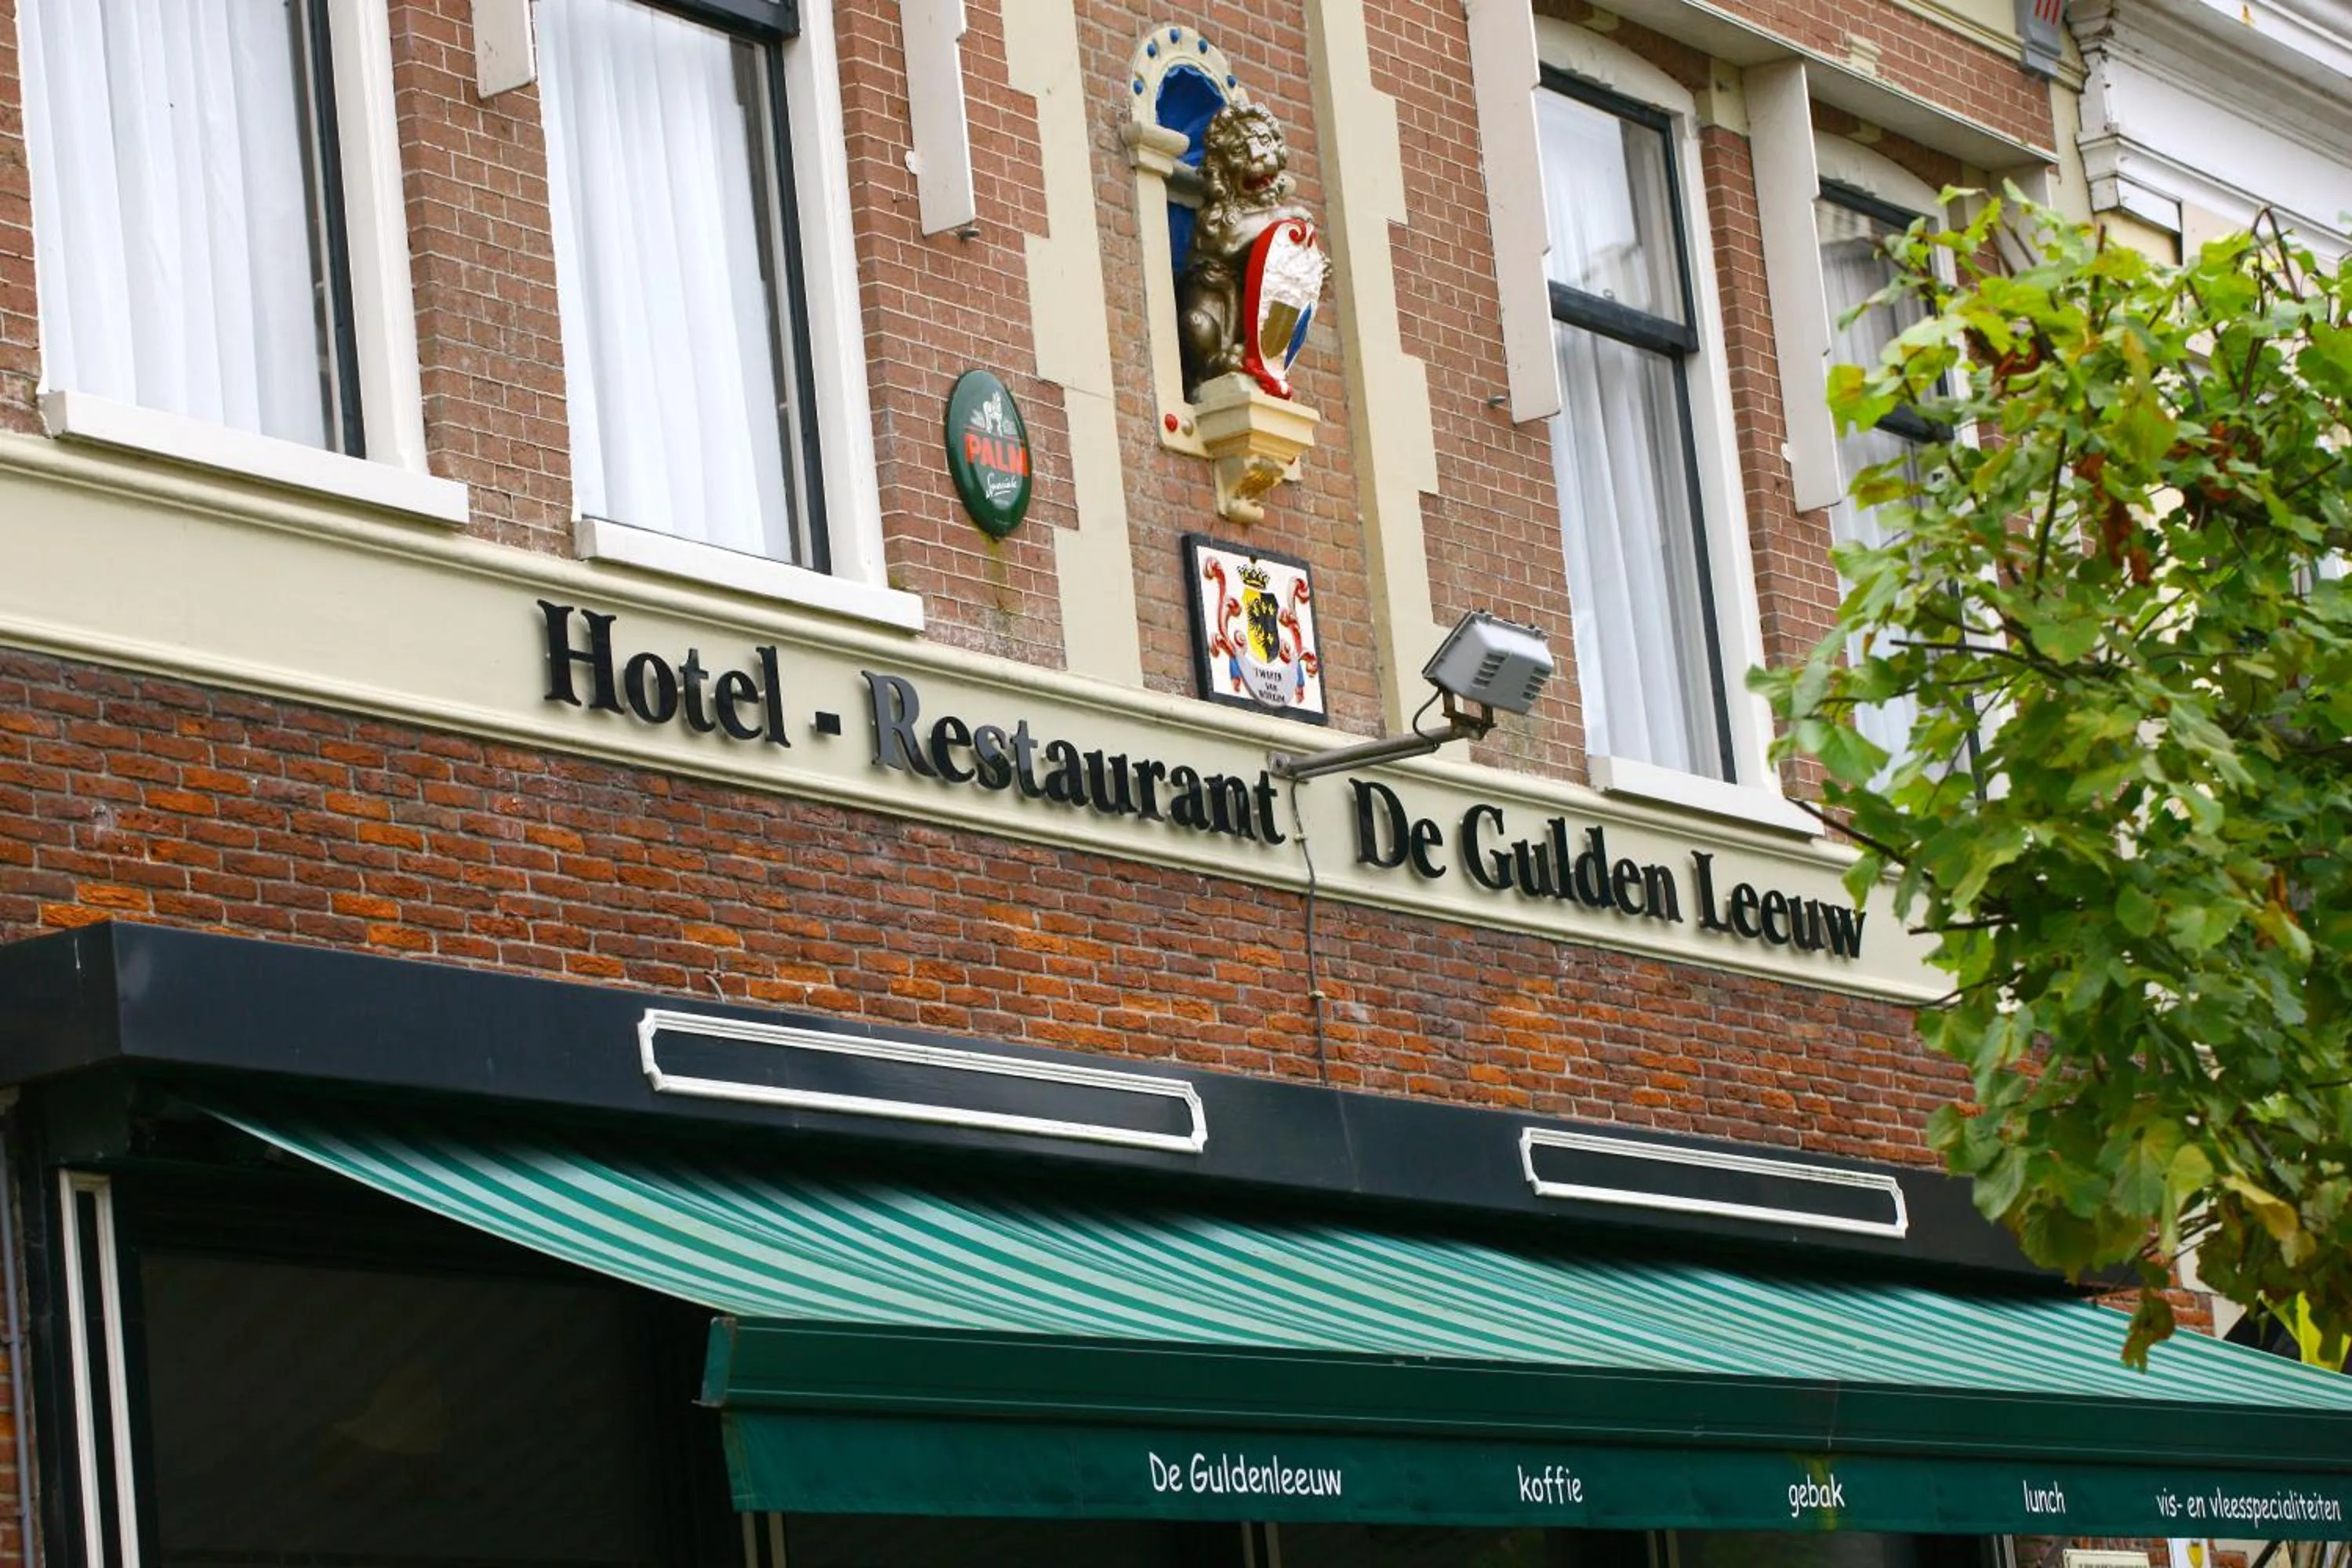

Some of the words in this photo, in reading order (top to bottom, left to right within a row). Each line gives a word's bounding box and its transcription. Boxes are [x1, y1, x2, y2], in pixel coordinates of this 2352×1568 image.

[965, 434, 1029, 477] PALM
[537, 599, 791, 748] Hotel
[814, 711, 841, 737] -
[861, 670, 1287, 848] Restaurant
[1348, 777, 1446, 882] De
[1461, 804, 1683, 923] Gulden
[1691, 850, 1867, 960] Leeuw
[1149, 1451, 1183, 1492] De
[1189, 1453, 1341, 1496] Guldenleeuw
[1517, 1465, 1583, 1504] koffie
[1788, 1473, 1846, 1518] gebak
[2023, 1479, 2066, 1513] lunch
[2156, 1487, 2183, 1517] vis-
[2187, 1496, 2206, 1519] en
[2209, 1487, 2342, 1528] vleesspecialiteiten
